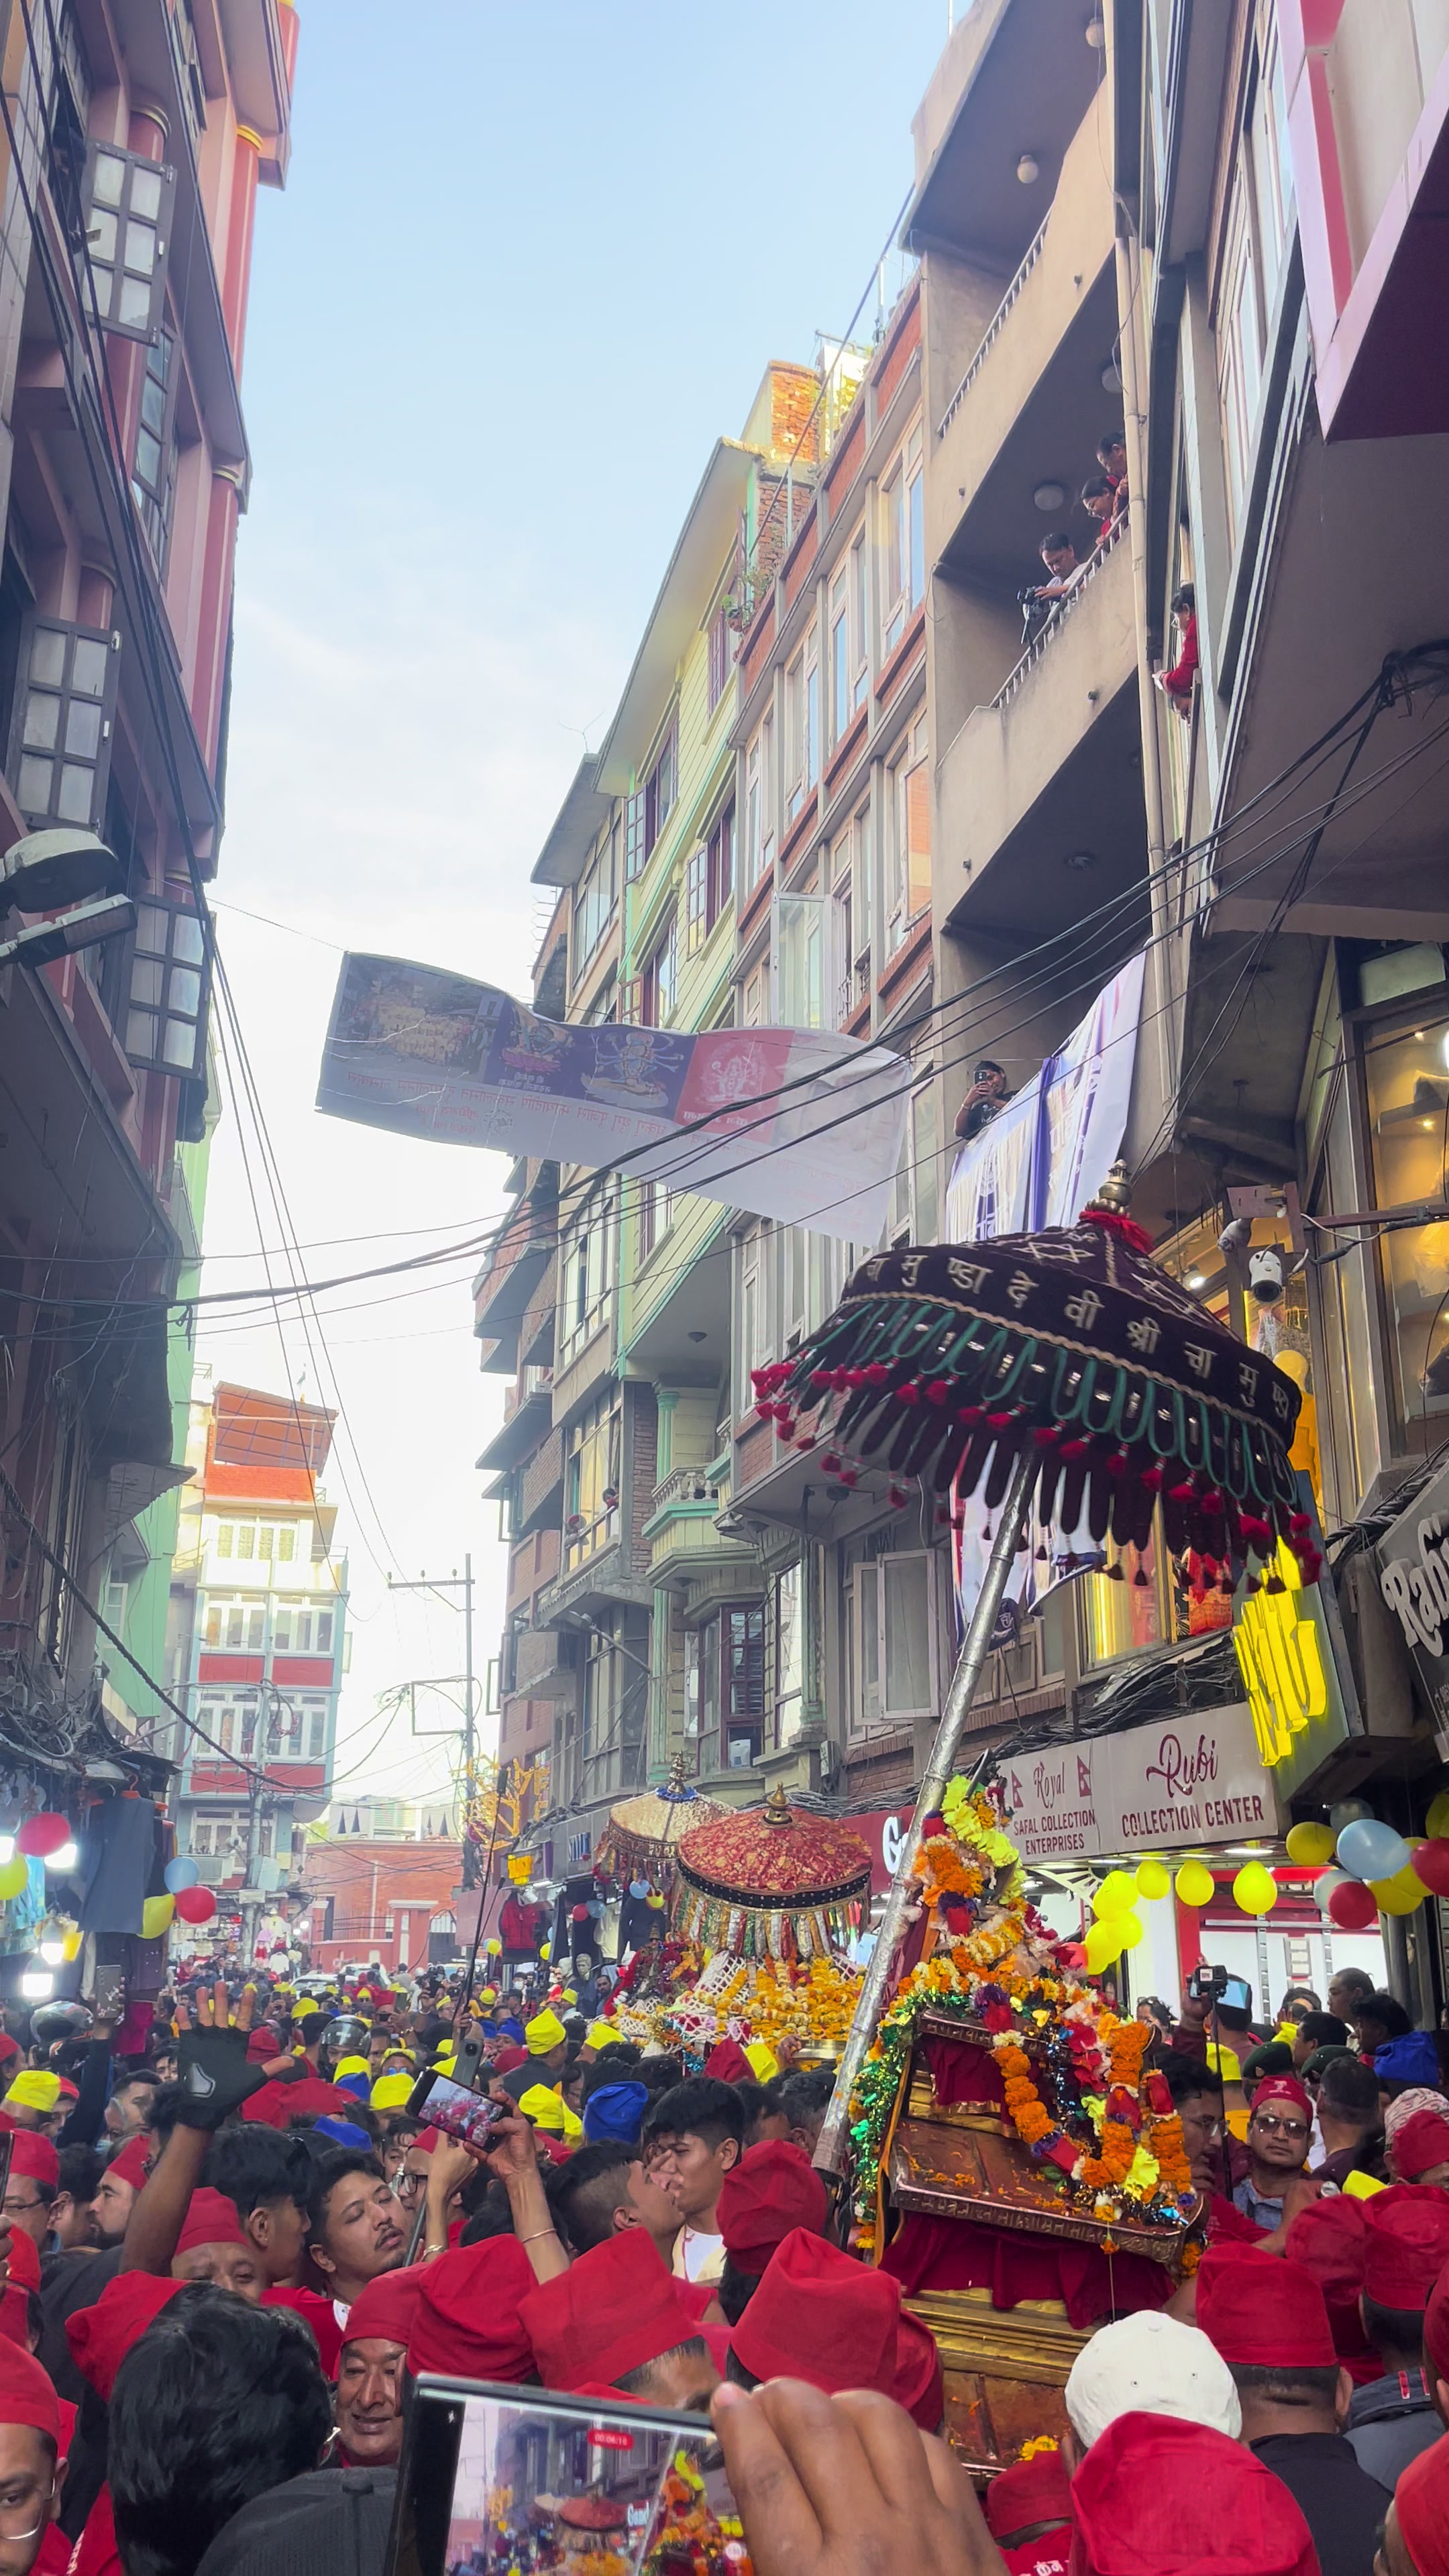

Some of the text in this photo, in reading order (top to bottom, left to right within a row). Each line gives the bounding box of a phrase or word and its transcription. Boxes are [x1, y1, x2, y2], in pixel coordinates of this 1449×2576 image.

[1033, 1761, 1065, 1809] Royal
[1146, 1734, 1218, 1799] Rubi
[1014, 1809, 1096, 1836] SAFAL COLLECTION
[1122, 1795, 1265, 1838] COLLECTION CENTER
[1025, 1833, 1085, 1856] ENTERPRISES
